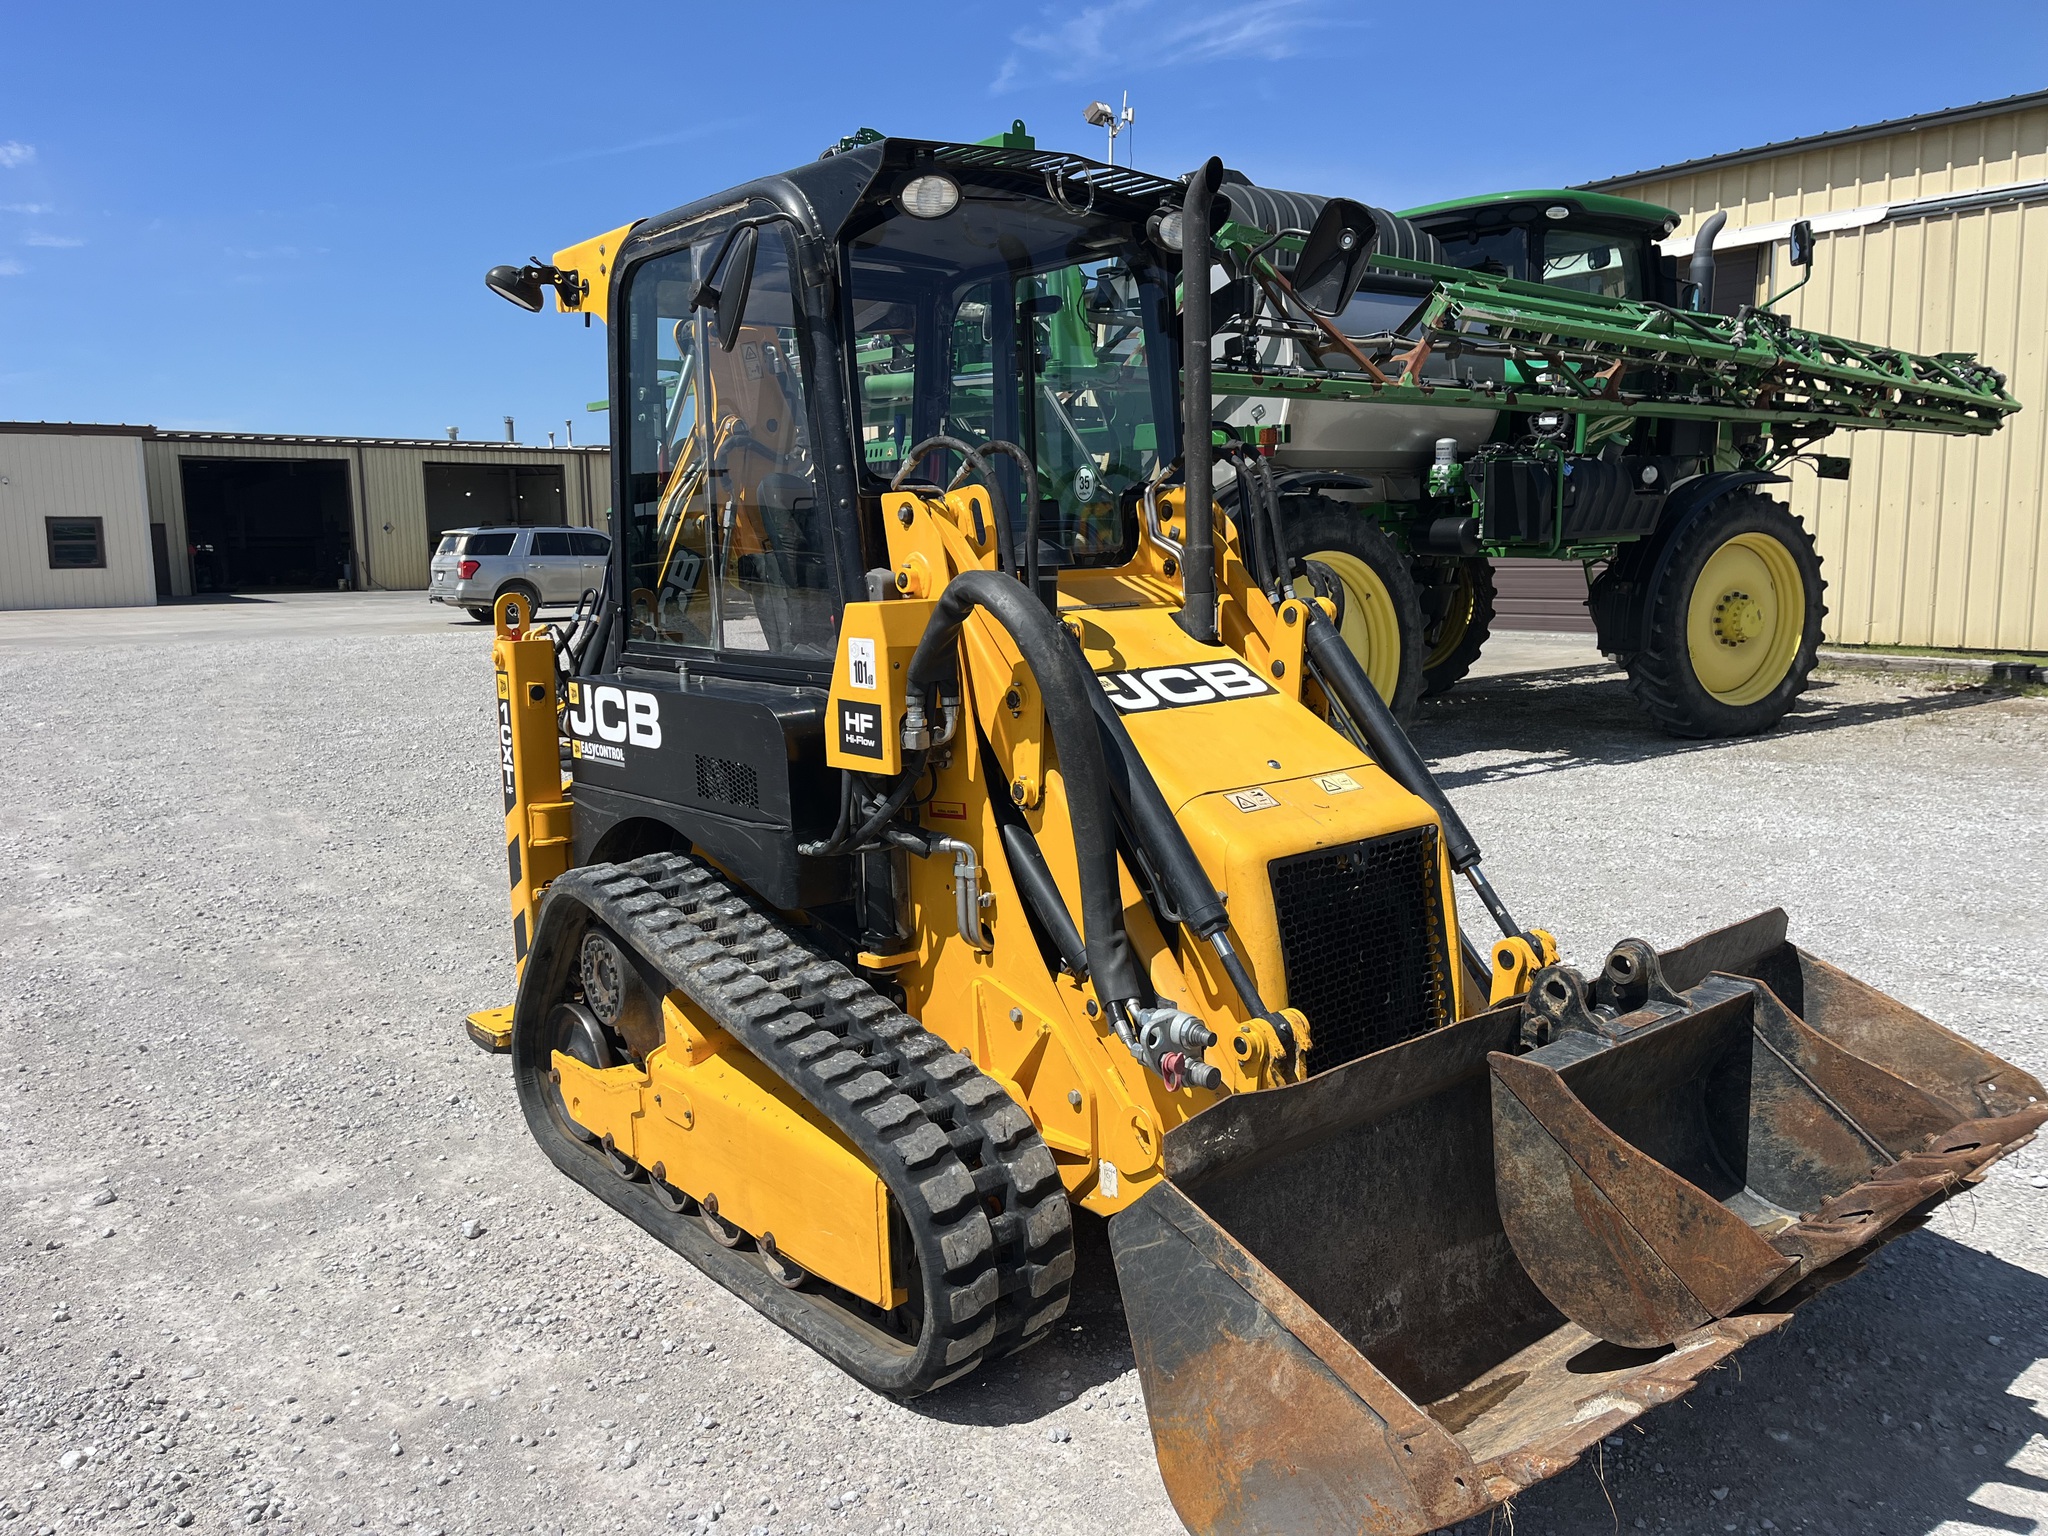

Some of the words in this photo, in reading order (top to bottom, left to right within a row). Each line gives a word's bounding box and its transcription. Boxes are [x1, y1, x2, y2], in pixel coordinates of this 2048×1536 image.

[1079, 475, 1090, 490] 35
[853, 660, 868, 685] 101
[1107, 662, 1269, 710] JCB
[569, 683, 662, 750] JCB
[844, 711, 873, 734] HF
[500, 701, 515, 786] 1CXT
[580, 740, 626, 762] EASYCONTROL
[845, 733, 876, 748] Hi-Flow
